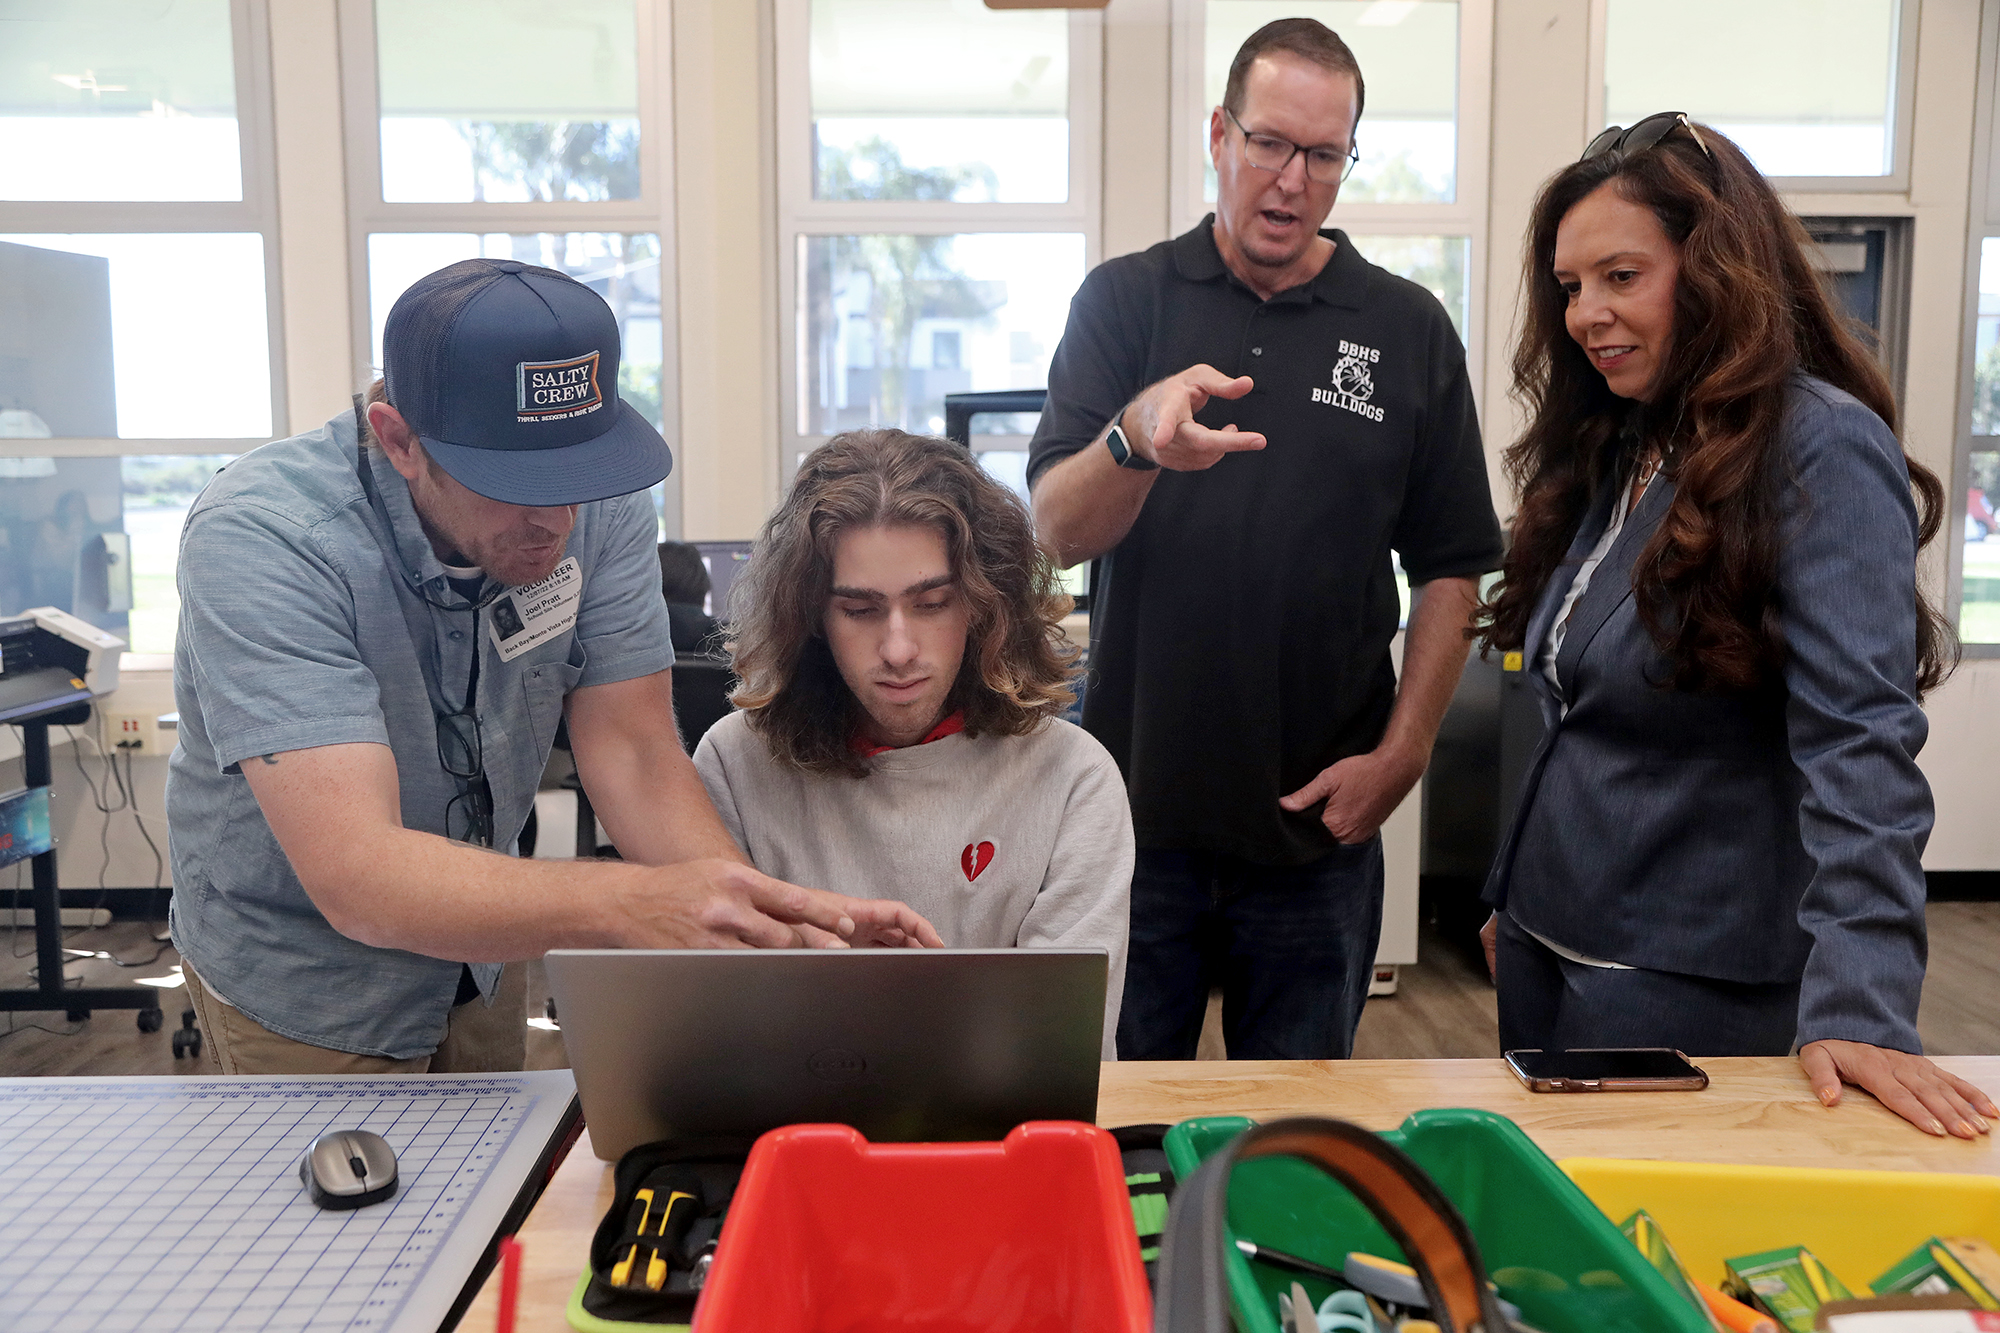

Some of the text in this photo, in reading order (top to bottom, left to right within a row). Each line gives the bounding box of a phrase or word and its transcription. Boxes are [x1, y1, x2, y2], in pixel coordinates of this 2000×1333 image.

[1338, 340, 1381, 363] BBHS
[532, 365, 589, 388] SALTY
[534, 382, 589, 405] CREW
[1311, 387, 1385, 422] BULLDOGS
[517, 415, 540, 423] THRILL
[516, 563, 574, 596] VOLUNTEER
[562, 574, 571, 582] AM
[525, 594, 561, 616] Joel Pratt
[527, 612, 543, 621] School
[504, 643, 518, 654] Back
[547, 622, 561, 632] Vista
[561, 614, 574, 625] High
